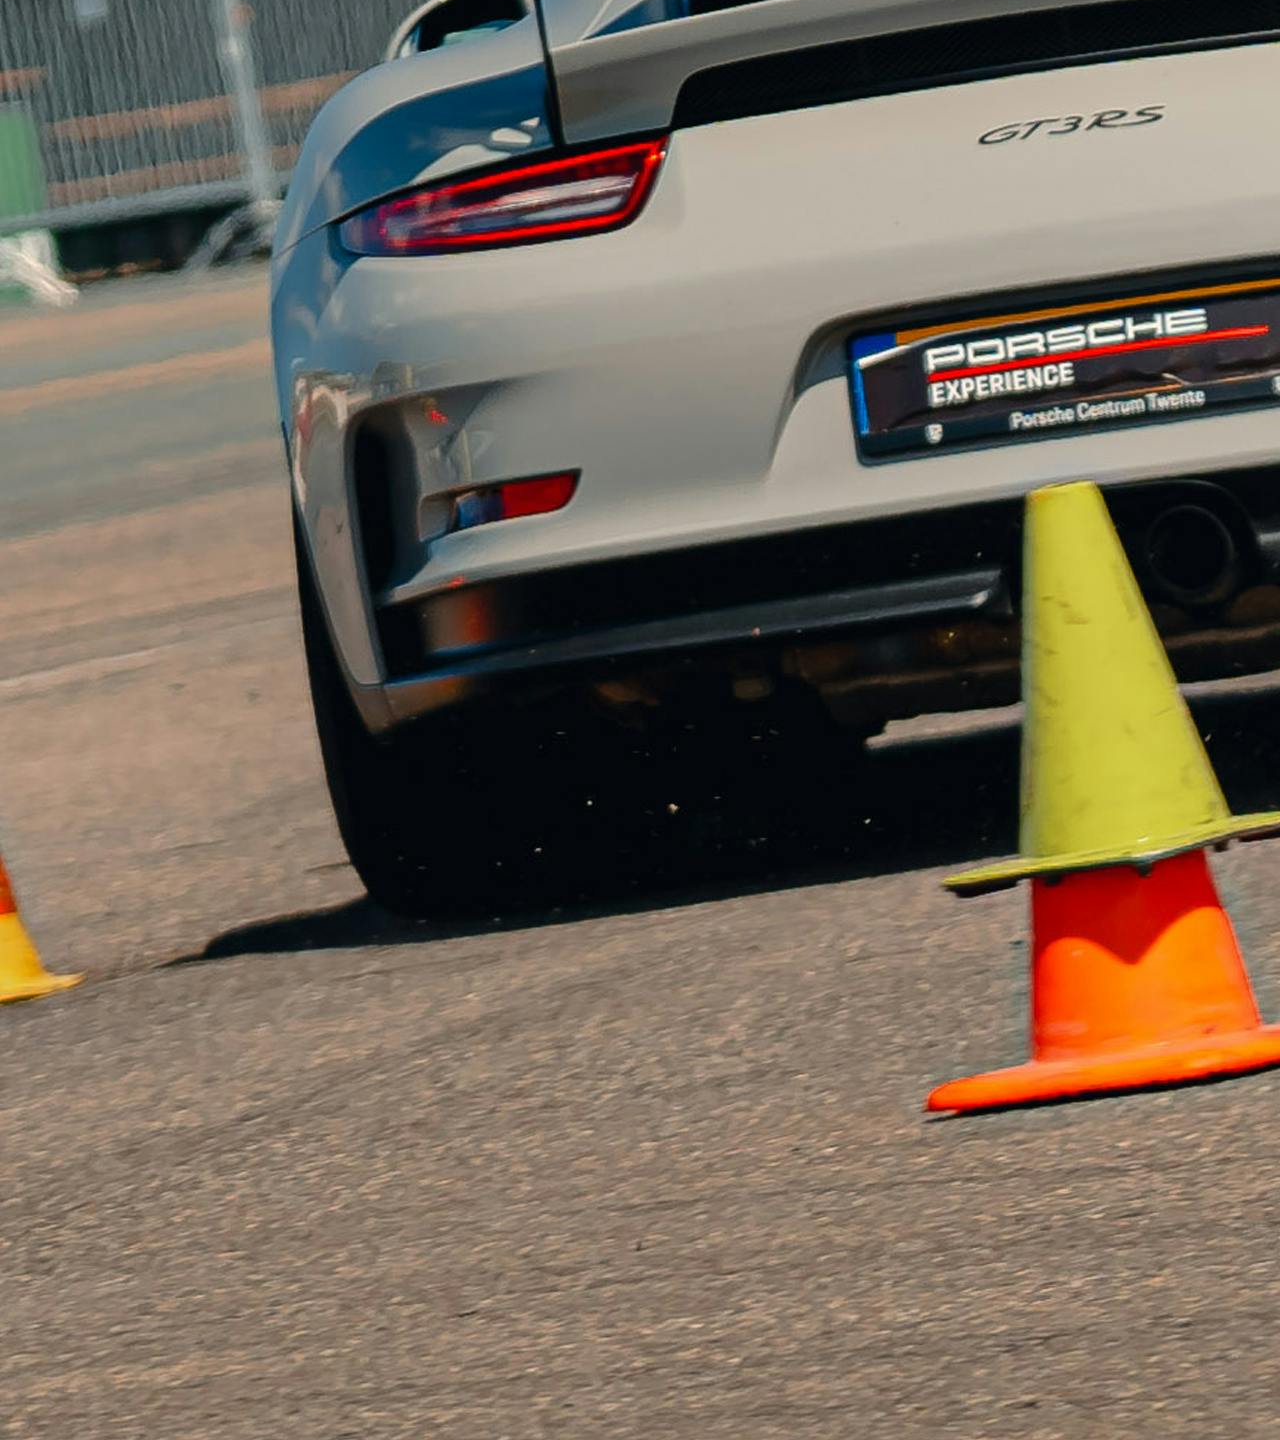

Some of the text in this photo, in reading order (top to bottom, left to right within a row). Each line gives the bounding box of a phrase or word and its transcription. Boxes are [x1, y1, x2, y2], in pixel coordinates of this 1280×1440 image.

[924, 308, 1208, 373] PORSCHE
[928, 362, 1076, 407] EXPERIENCE
[1009, 390, 1206, 430] Porsche Centrum Twente
